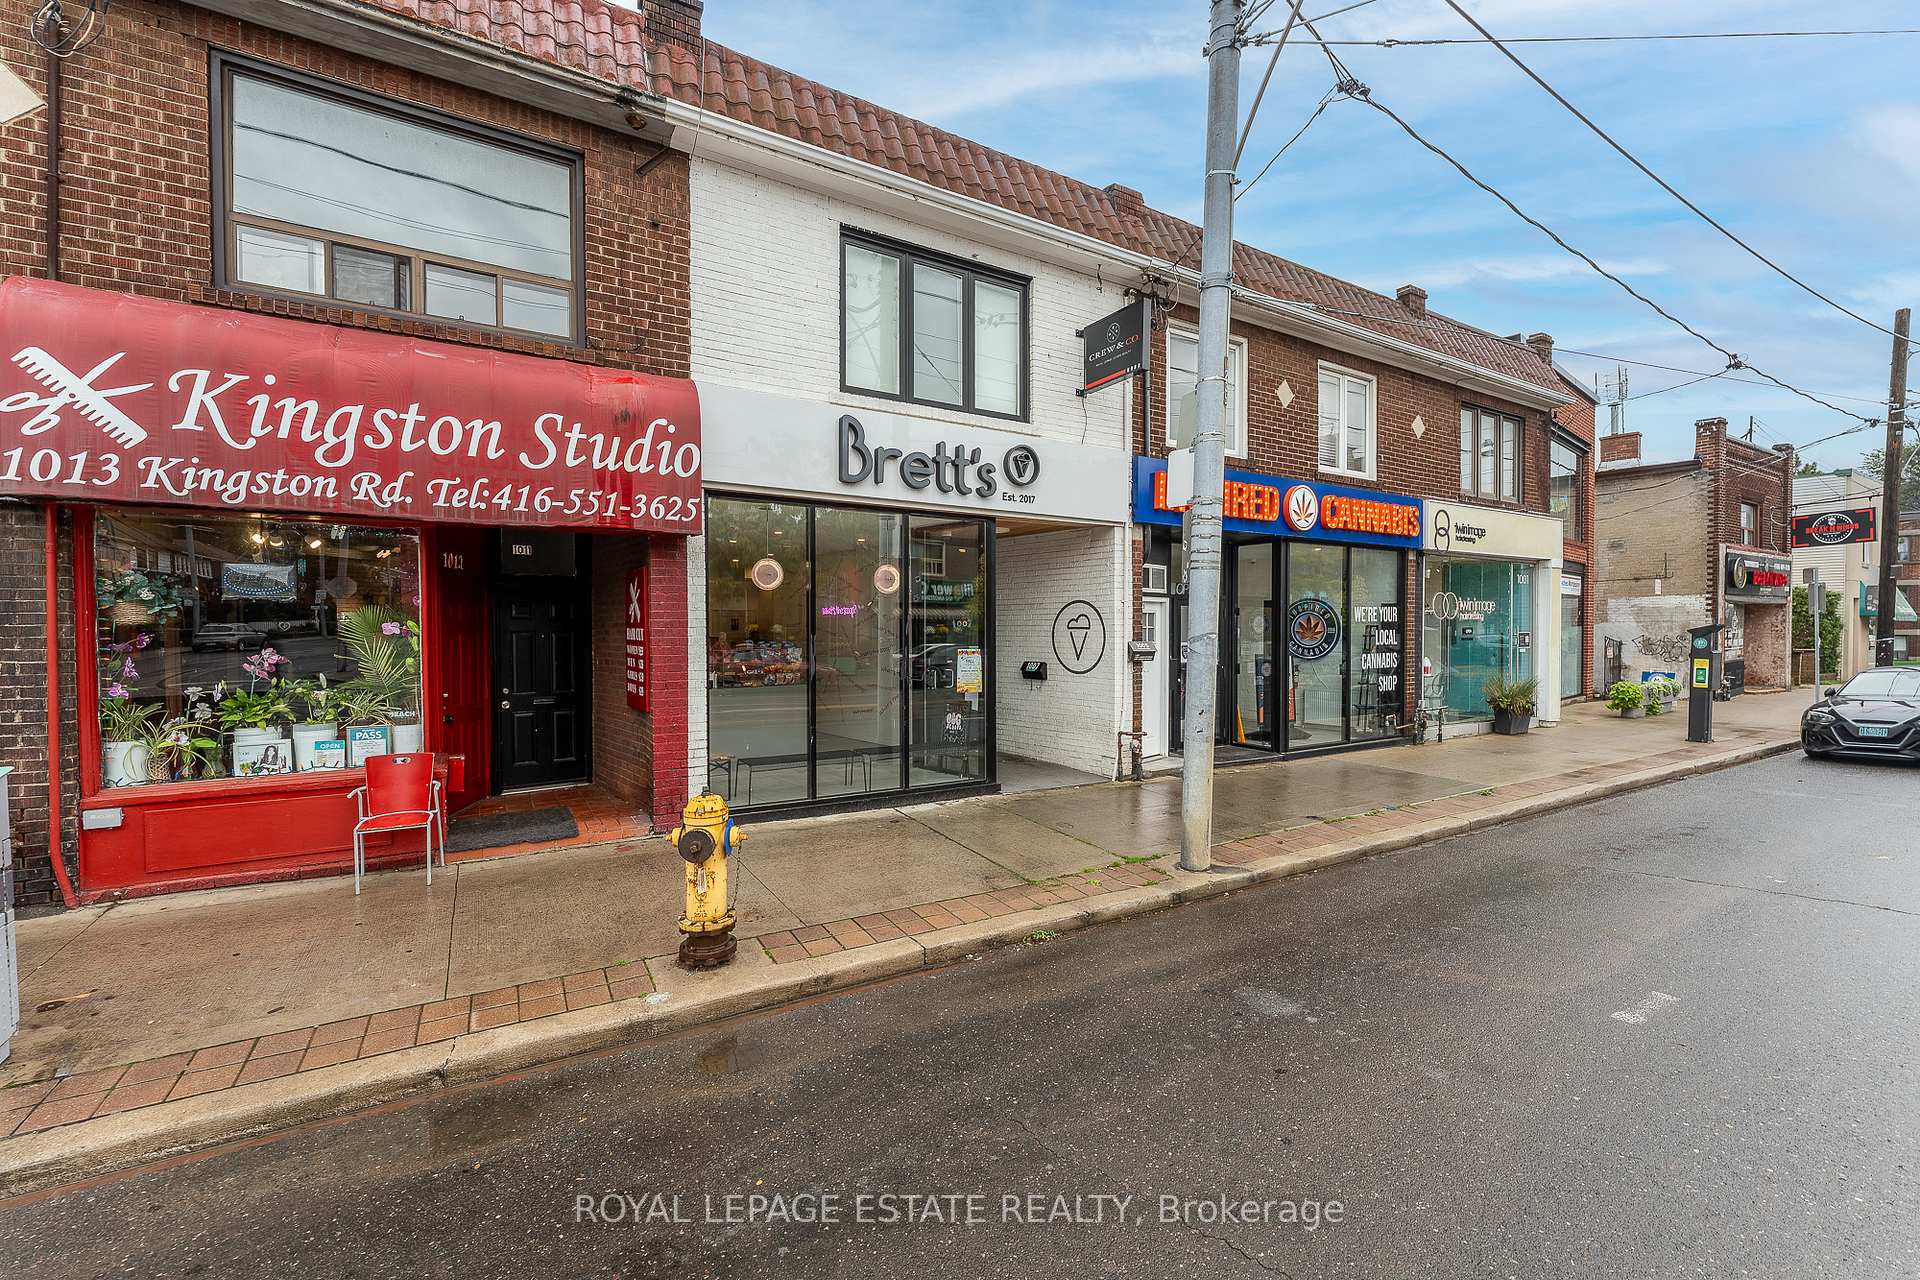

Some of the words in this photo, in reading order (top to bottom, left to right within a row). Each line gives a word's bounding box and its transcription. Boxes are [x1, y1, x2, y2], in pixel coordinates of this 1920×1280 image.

[168, 369, 505, 468] Kingston
[519, 413, 701, 478] Studio
[838, 414, 998, 498] Brett's
[0, 447, 121, 486] 1013
[137, 456, 339, 504] Kingston
[350, 471, 415, 508] Rd.
[1002, 492, 1018, 503] Est.
[1019, 494, 1036, 505] 2017
[1320, 494, 1420, 538] CANNABIS
[1516, 573, 1530, 585] 1001
[1354, 605, 1378, 623] WE'RE
[1378, 605, 1398, 622] YOUR
[1375, 628, 1398, 646] LOCAL
[1289, 640, 1330, 656] CANNABIS
[1361, 652, 1398, 670] CANNABIS
[1378, 674, 1398, 692] SHOP
[355, 730, 382, 740] PASS
[319, 742, 341, 750] OPEN
